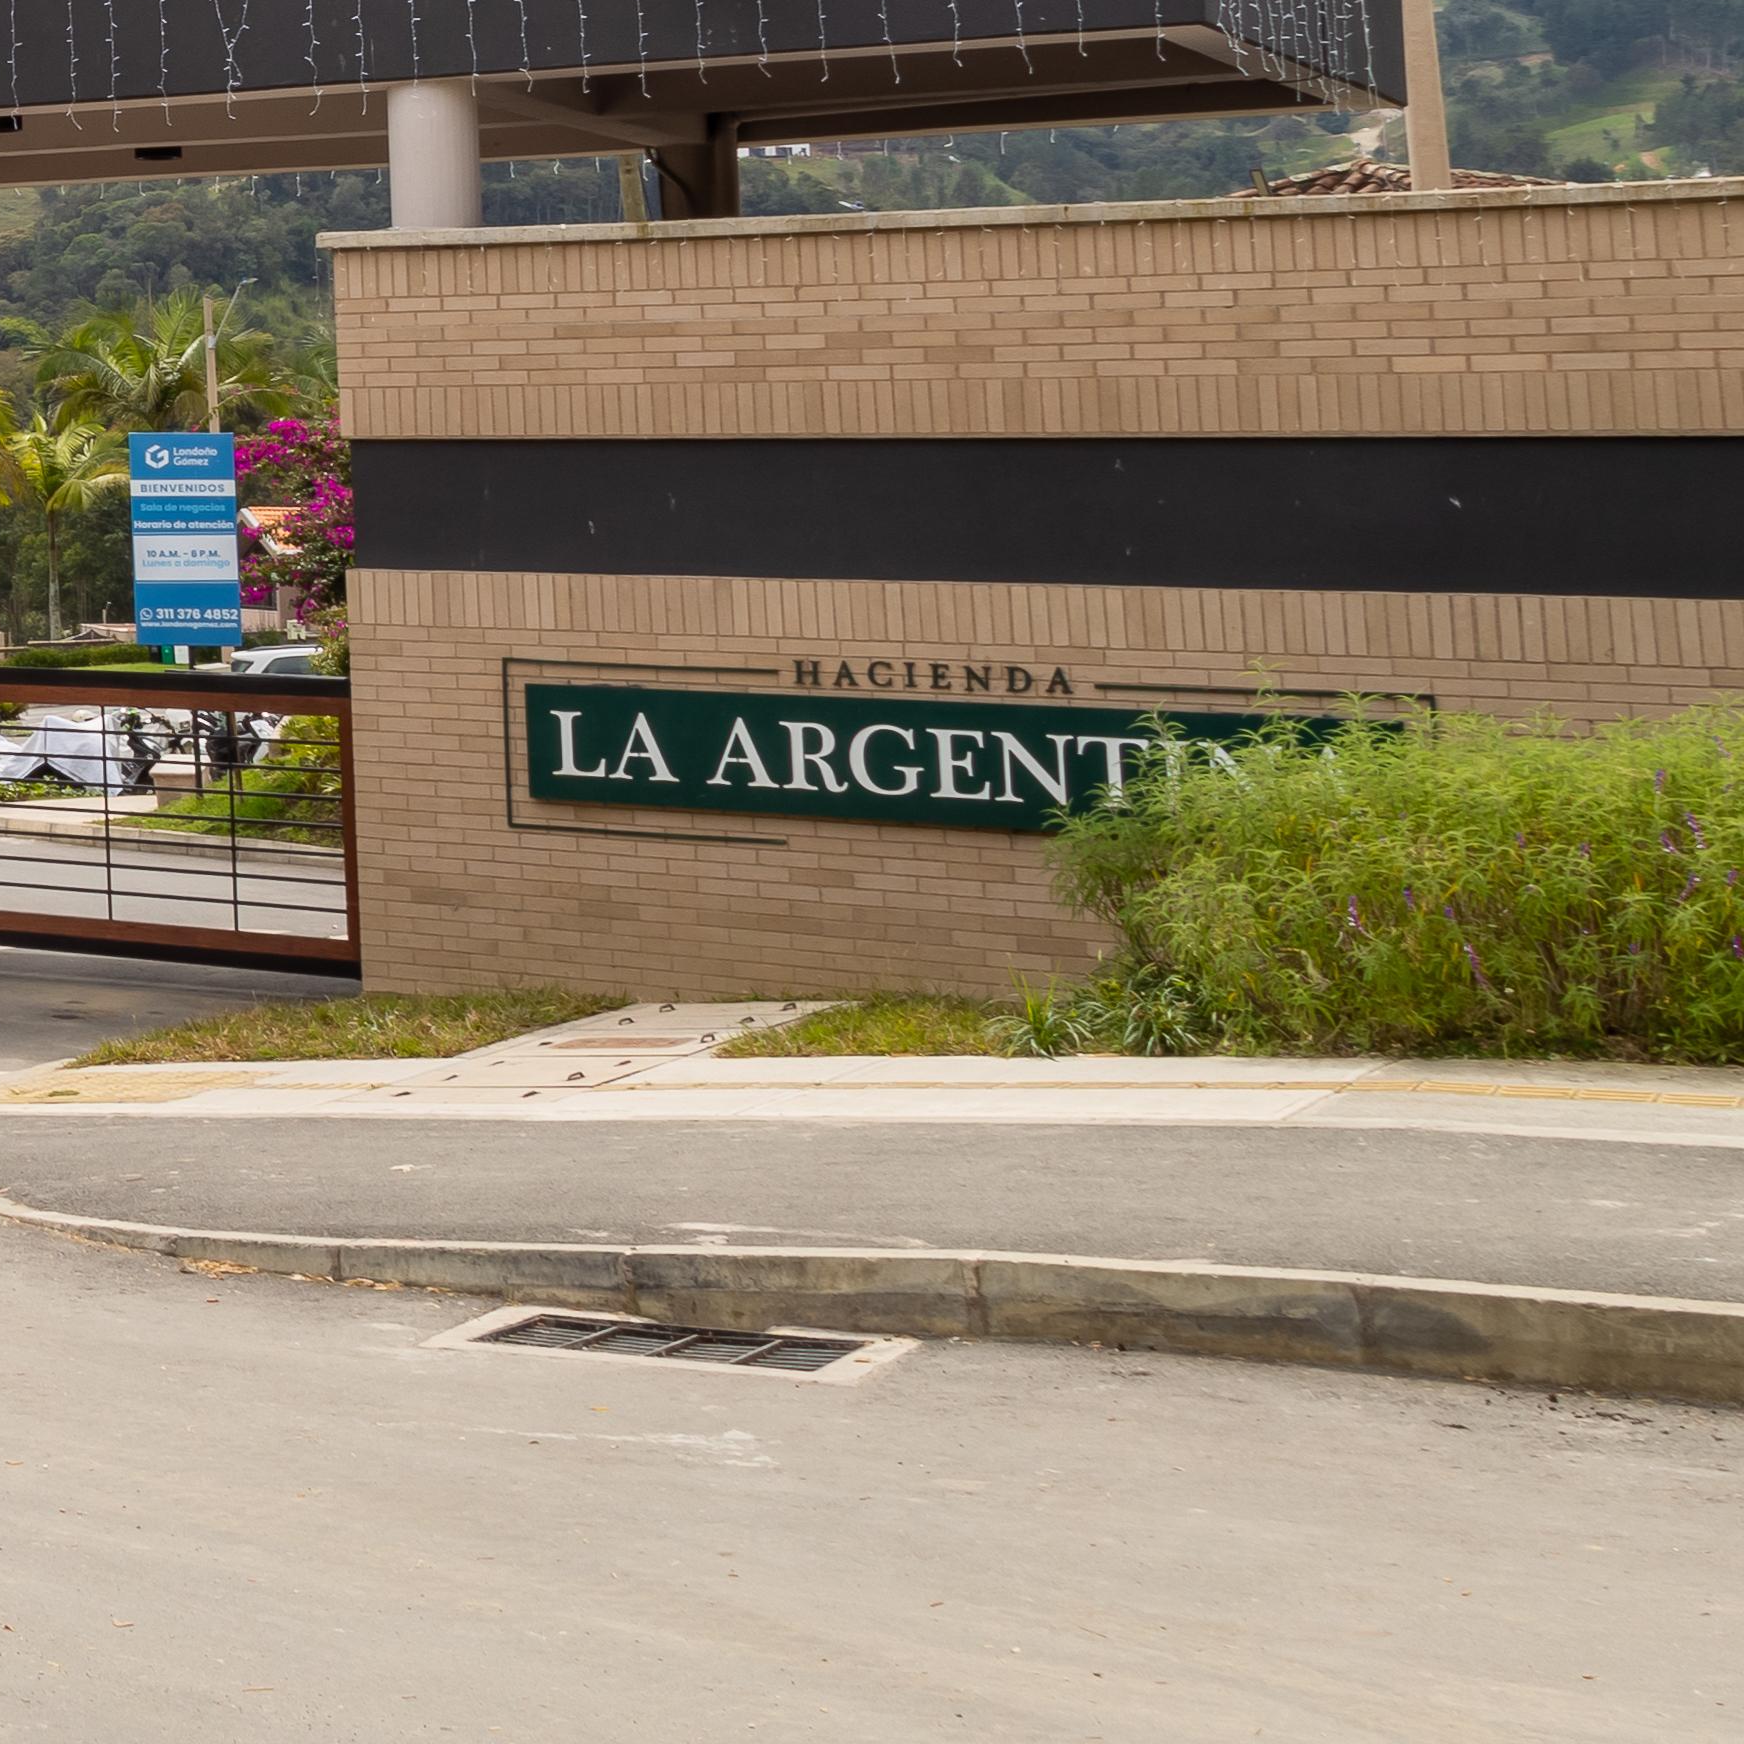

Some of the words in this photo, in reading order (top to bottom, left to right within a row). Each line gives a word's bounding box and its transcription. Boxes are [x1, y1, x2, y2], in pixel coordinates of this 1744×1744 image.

[172, 446, 218, 456] Londoño
[140, 483, 225, 493] BIENVENIDOS
[140, 503, 163, 512] Sala
[164, 503, 177, 512] de
[179, 503, 226, 514] negocios
[133, 520, 173, 529] Horario
[173, 520, 187, 529] de
[187, 520, 235, 529] atención
[146, 549, 157, 558] 10
[142, 559, 172, 567] Lunes
[183, 559, 231, 569] domingo
[155, 608, 175, 619] 311
[203, 608, 239, 620] 4852
[792, 659, 1074, 695] HACIENDA
[549, 710, 680, 783] LA
[706, 716, 1350, 812] ARGENT
